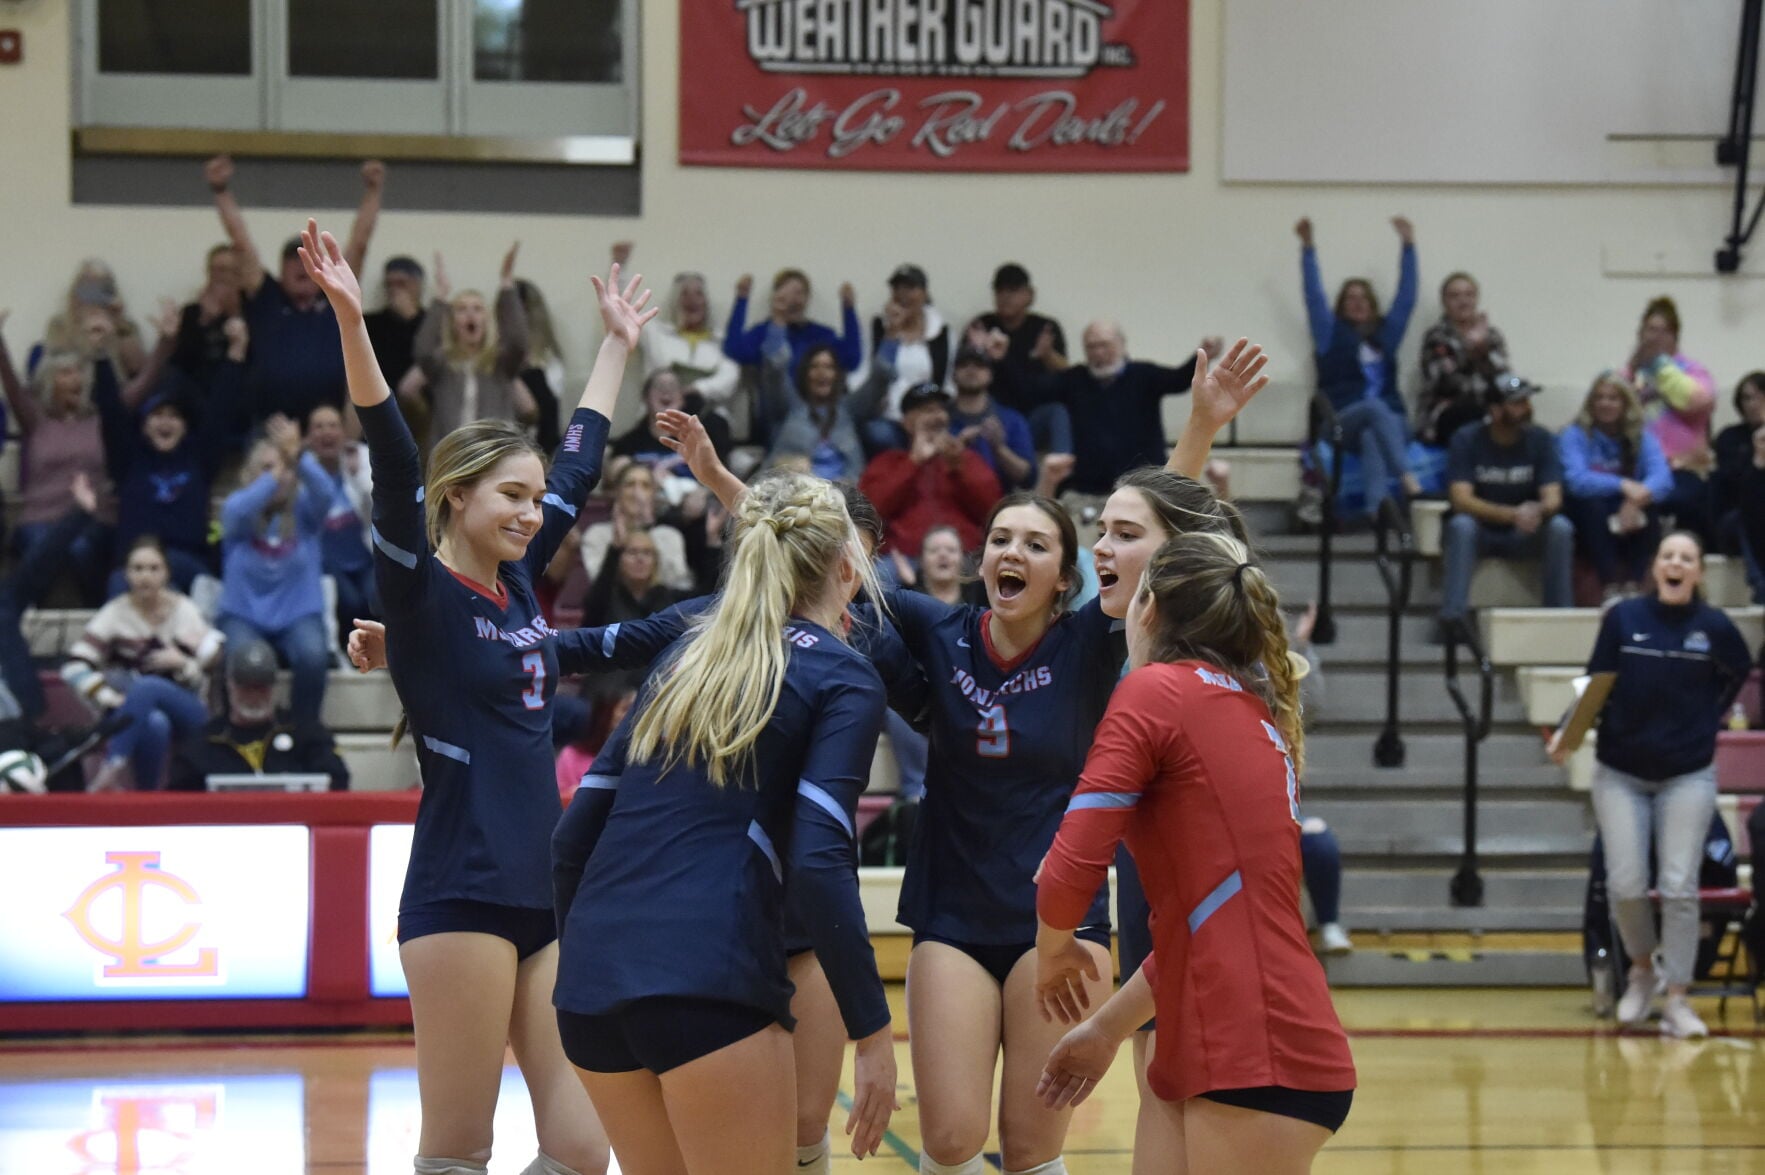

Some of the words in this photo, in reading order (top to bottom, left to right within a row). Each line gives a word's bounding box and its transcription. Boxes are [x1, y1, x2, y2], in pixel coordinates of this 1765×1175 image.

[748, 0, 947, 62] WEATHER
[955, 0, 1099, 66] GUARD
[828, 88, 904, 158] Go
[912, 91, 1009, 157] Red
[563, 423, 585, 453] MMHS
[522, 650, 546, 710] 3
[950, 665, 1052, 707] MONCHS
[977, 704, 1010, 757] 9
